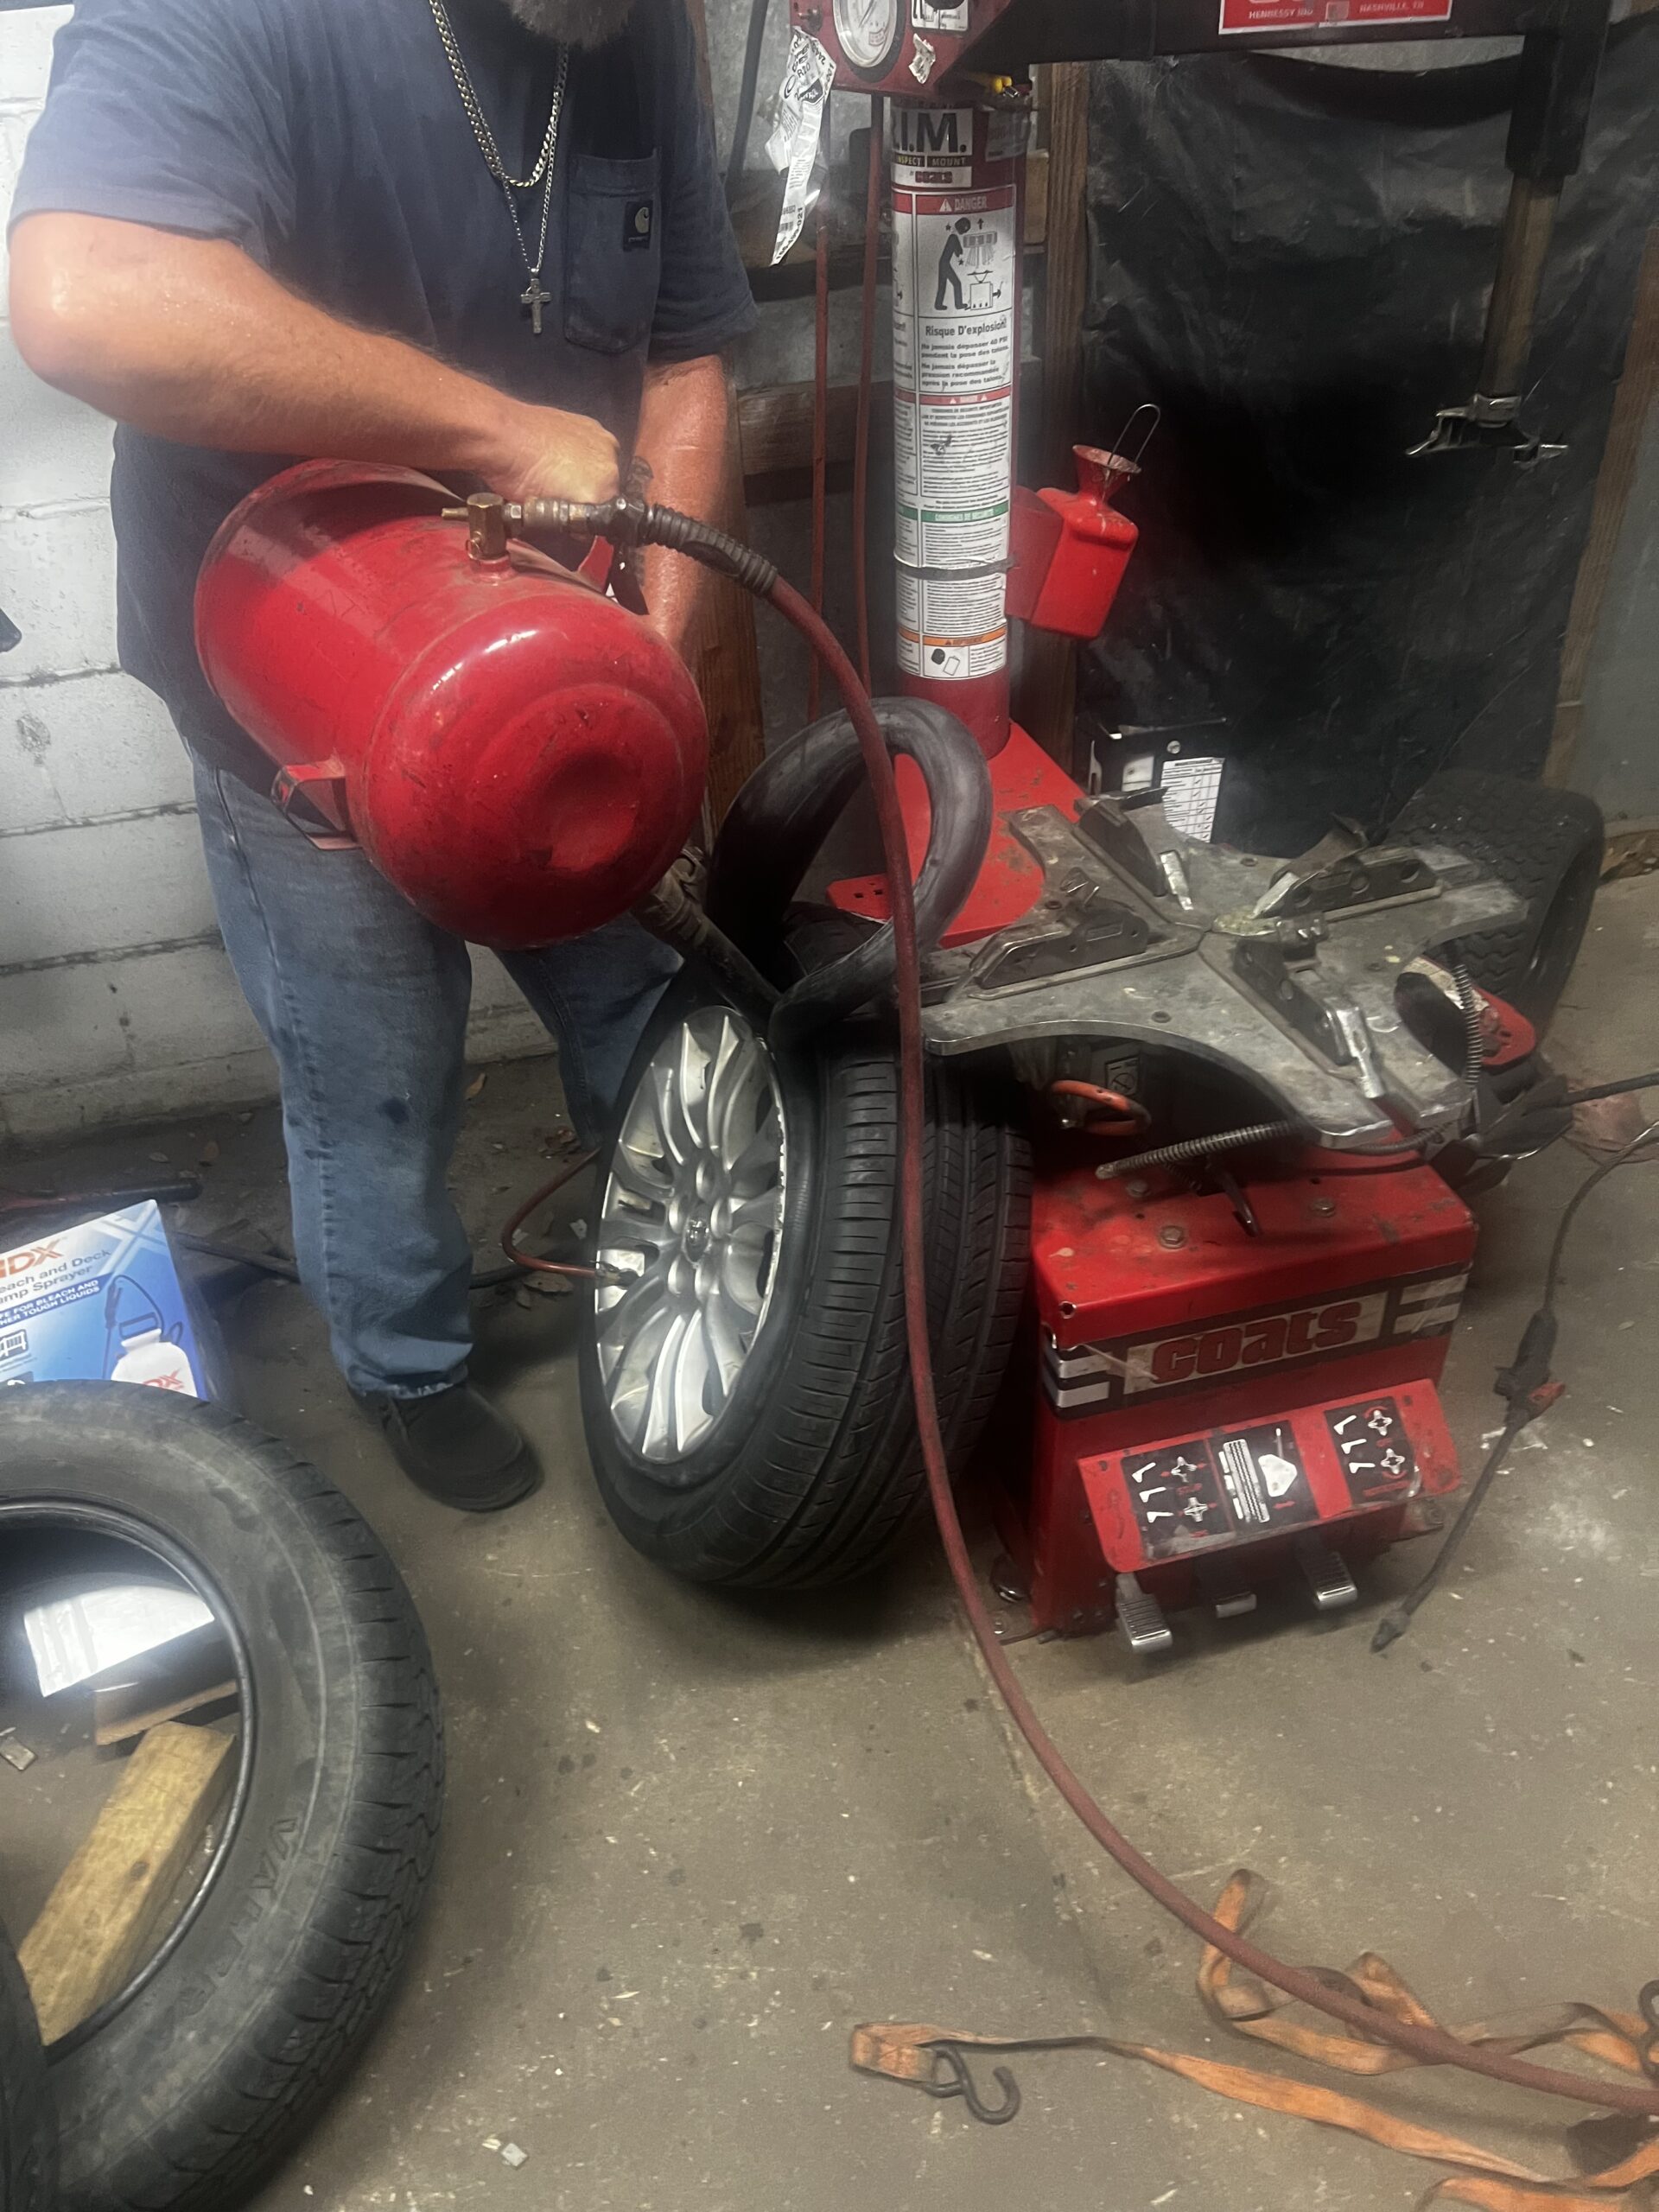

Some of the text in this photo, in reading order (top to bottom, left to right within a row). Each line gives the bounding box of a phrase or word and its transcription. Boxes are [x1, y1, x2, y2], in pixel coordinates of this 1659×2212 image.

[932, 157, 967, 167] MOUNT
[955, 196, 988, 211] DANGER
[925, 326, 955, 339] Risque
[39, 1262, 68, 1280] and
[72, 1249, 111, 1268] Deck
[33, 1265, 93, 1292] Sprayer
[13, 1302, 35, 1314] FOR
[35, 1287, 76, 1306] BLEACH
[78, 1279, 99, 1292] AND
[23, 1300, 59, 1317] TOUGH
[60, 1286, 101, 1304] LIQUIDS
